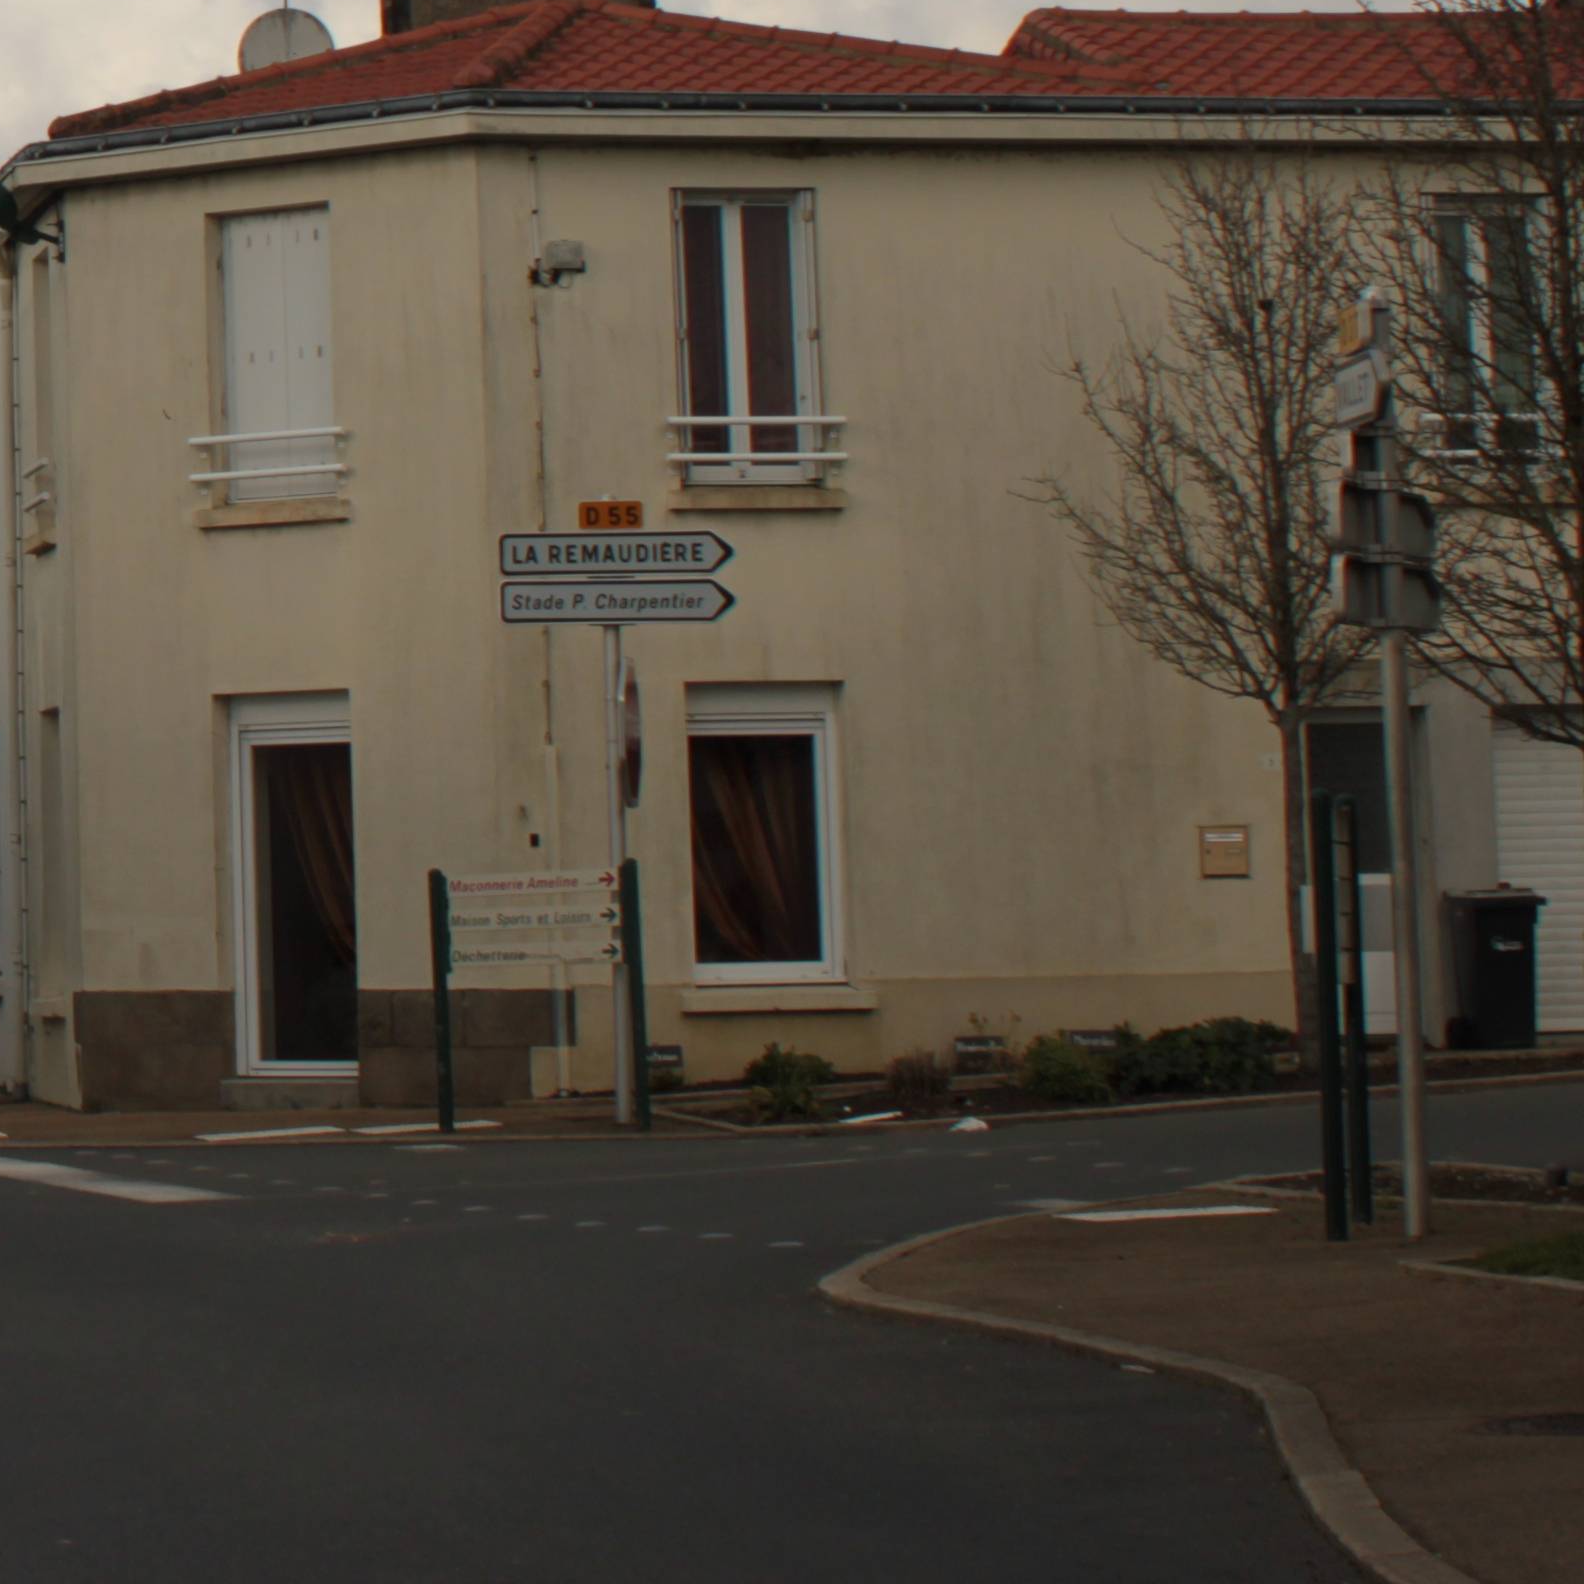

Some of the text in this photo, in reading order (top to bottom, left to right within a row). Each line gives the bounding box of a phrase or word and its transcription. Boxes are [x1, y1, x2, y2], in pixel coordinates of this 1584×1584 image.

[586, 506, 640, 525] D 55
[512, 541, 704, 564] LA REMAUDIÈRE
[512, 594, 564, 610] Stade
[595, 593, 704, 613] Charpentier
